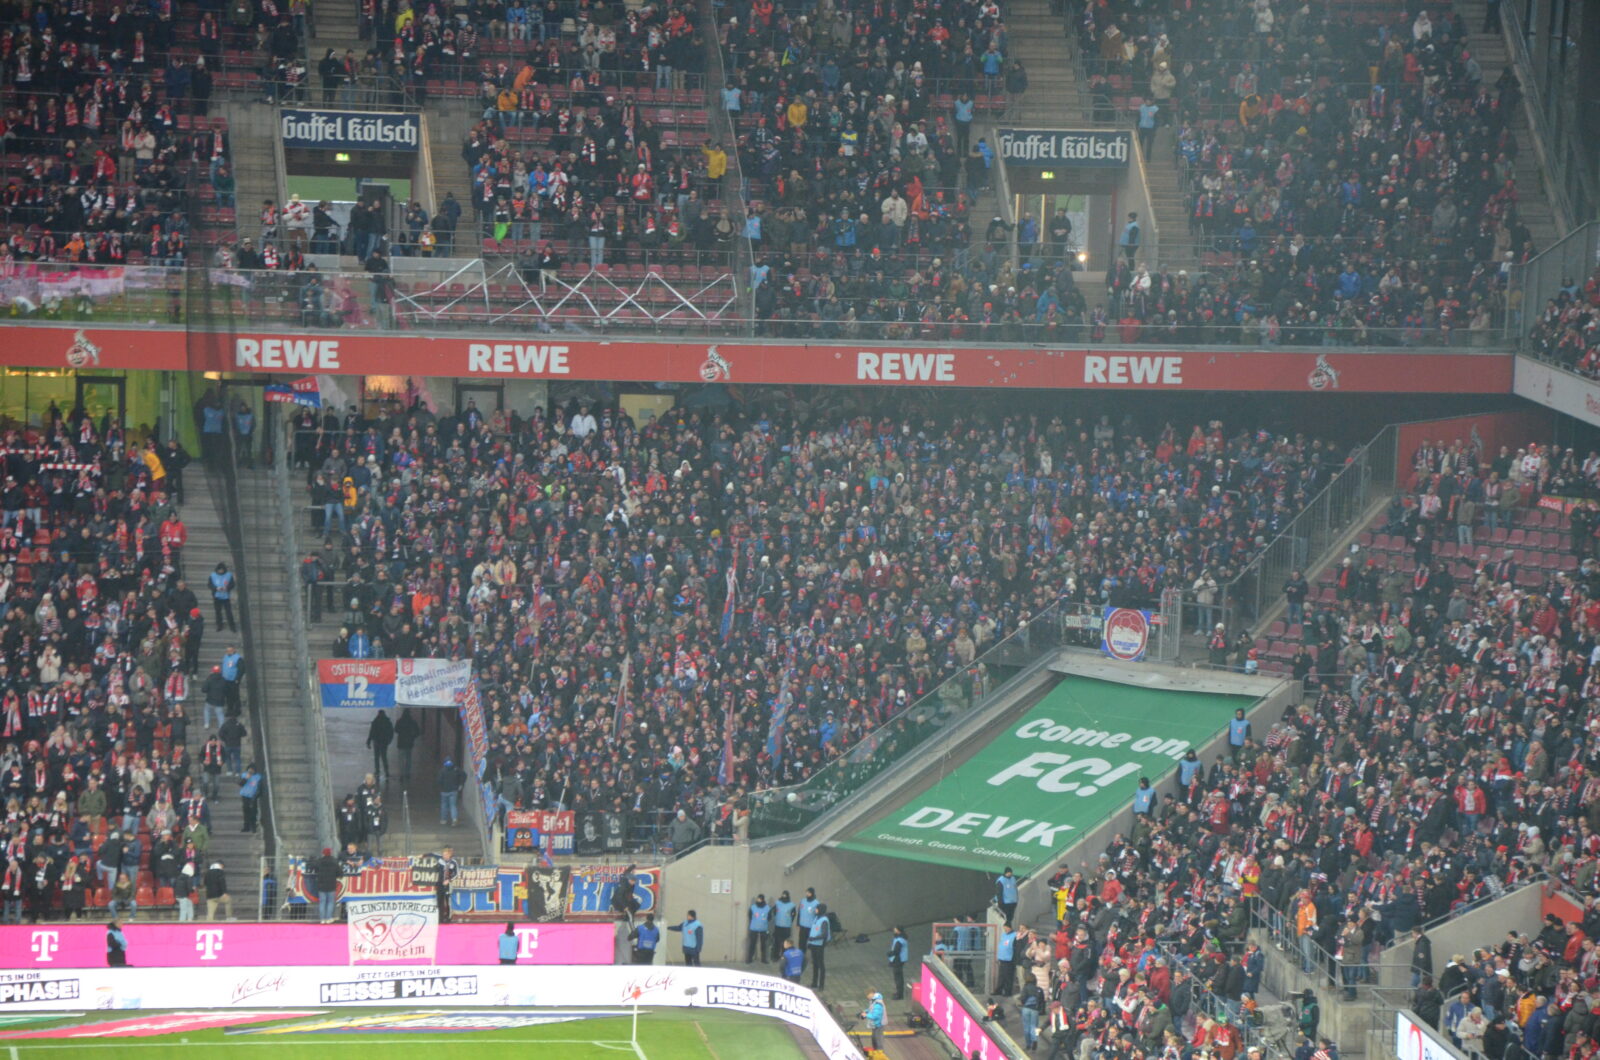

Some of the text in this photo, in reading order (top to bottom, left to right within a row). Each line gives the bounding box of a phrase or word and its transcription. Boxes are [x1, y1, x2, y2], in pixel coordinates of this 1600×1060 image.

[282, 113, 417, 146] Gaffel Kölsch
[1000, 134, 1128, 162] Gaffel Kölsch
[236, 338, 340, 369] REWE
[469, 344, 570, 374] REWE
[857, 352, 955, 381] REWE
[1084, 356, 1182, 384] REWE
[331, 662, 381, 677] OSTTRIBÜNE
[1015, 718, 1133, 748] Come
[986, 751, 1142, 797] FC!
[898, 806, 1075, 847] DEVK
[0, 980, 79, 1002] PHASE!
[321, 977, 478, 1002] HEISSE PHASE!
[708, 985, 770, 1008] HEISSE
